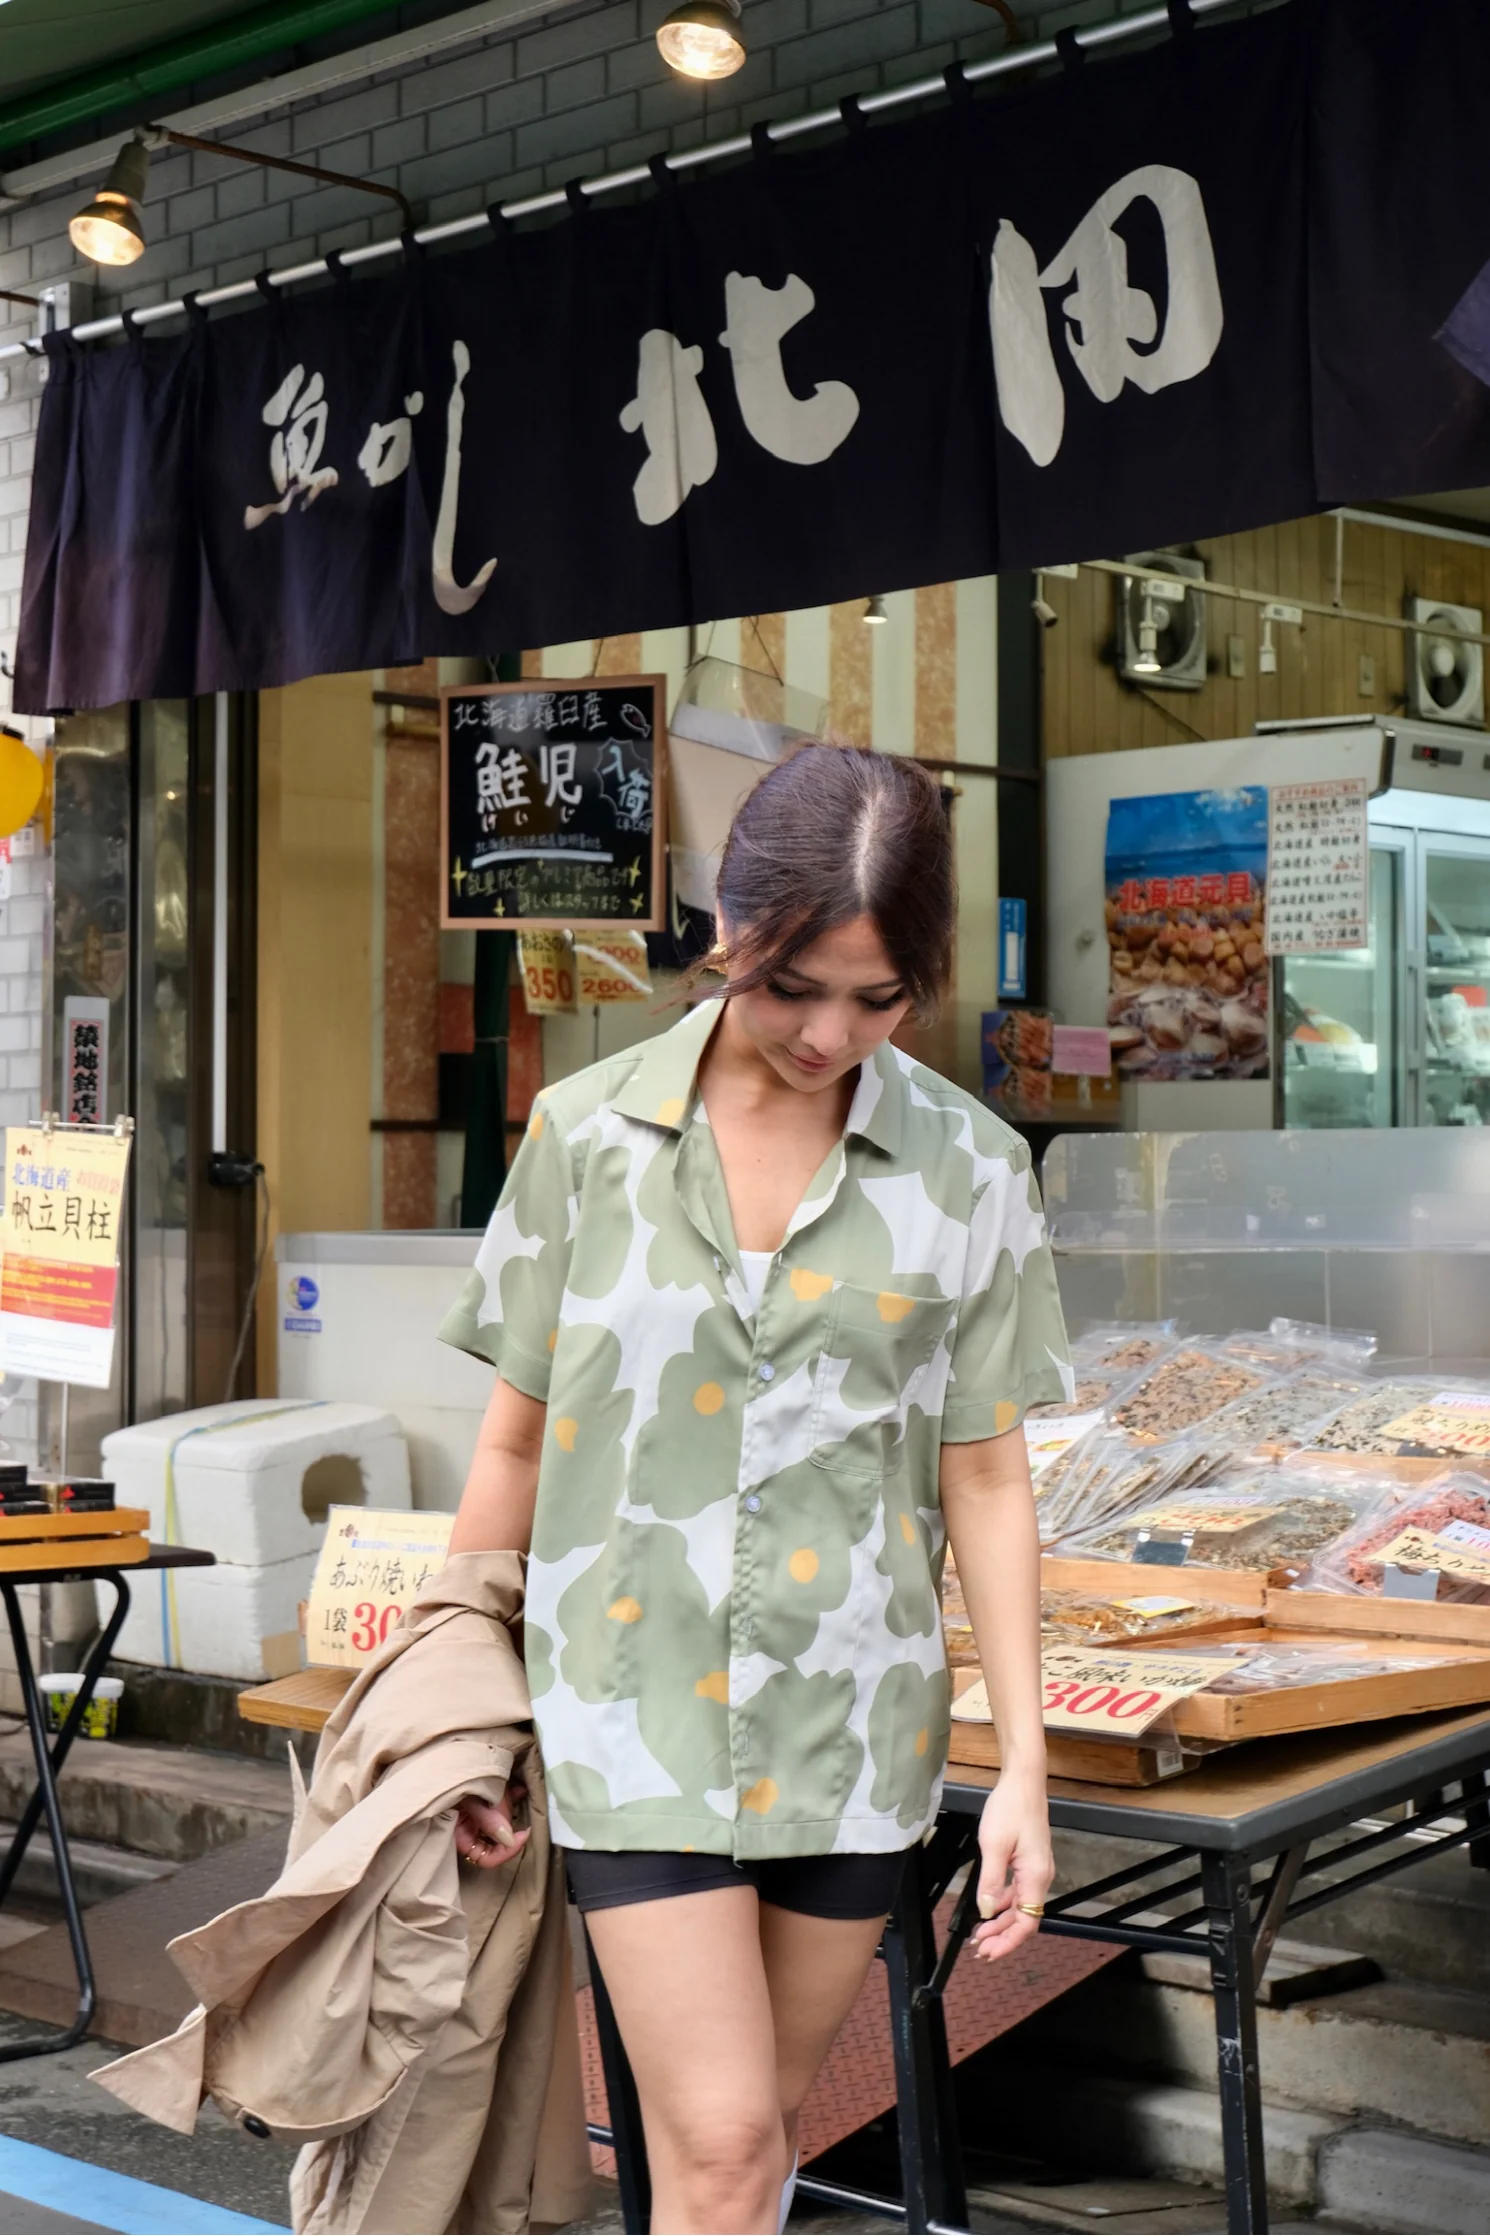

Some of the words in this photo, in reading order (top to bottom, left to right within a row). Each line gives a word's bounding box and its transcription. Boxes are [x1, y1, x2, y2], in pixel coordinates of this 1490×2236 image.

[244, 340, 498, 615] 魚がし
[454, 691, 608, 733] 北海道羅臼産
[474, 741, 583, 814] 鮭児
[526, 966, 573, 1002] 350
[12, 1162, 71, 1191] 北海道産
[11, 1190, 112, 1241] 帆立貝柱
[1041, 1681, 1162, 1719] 300
